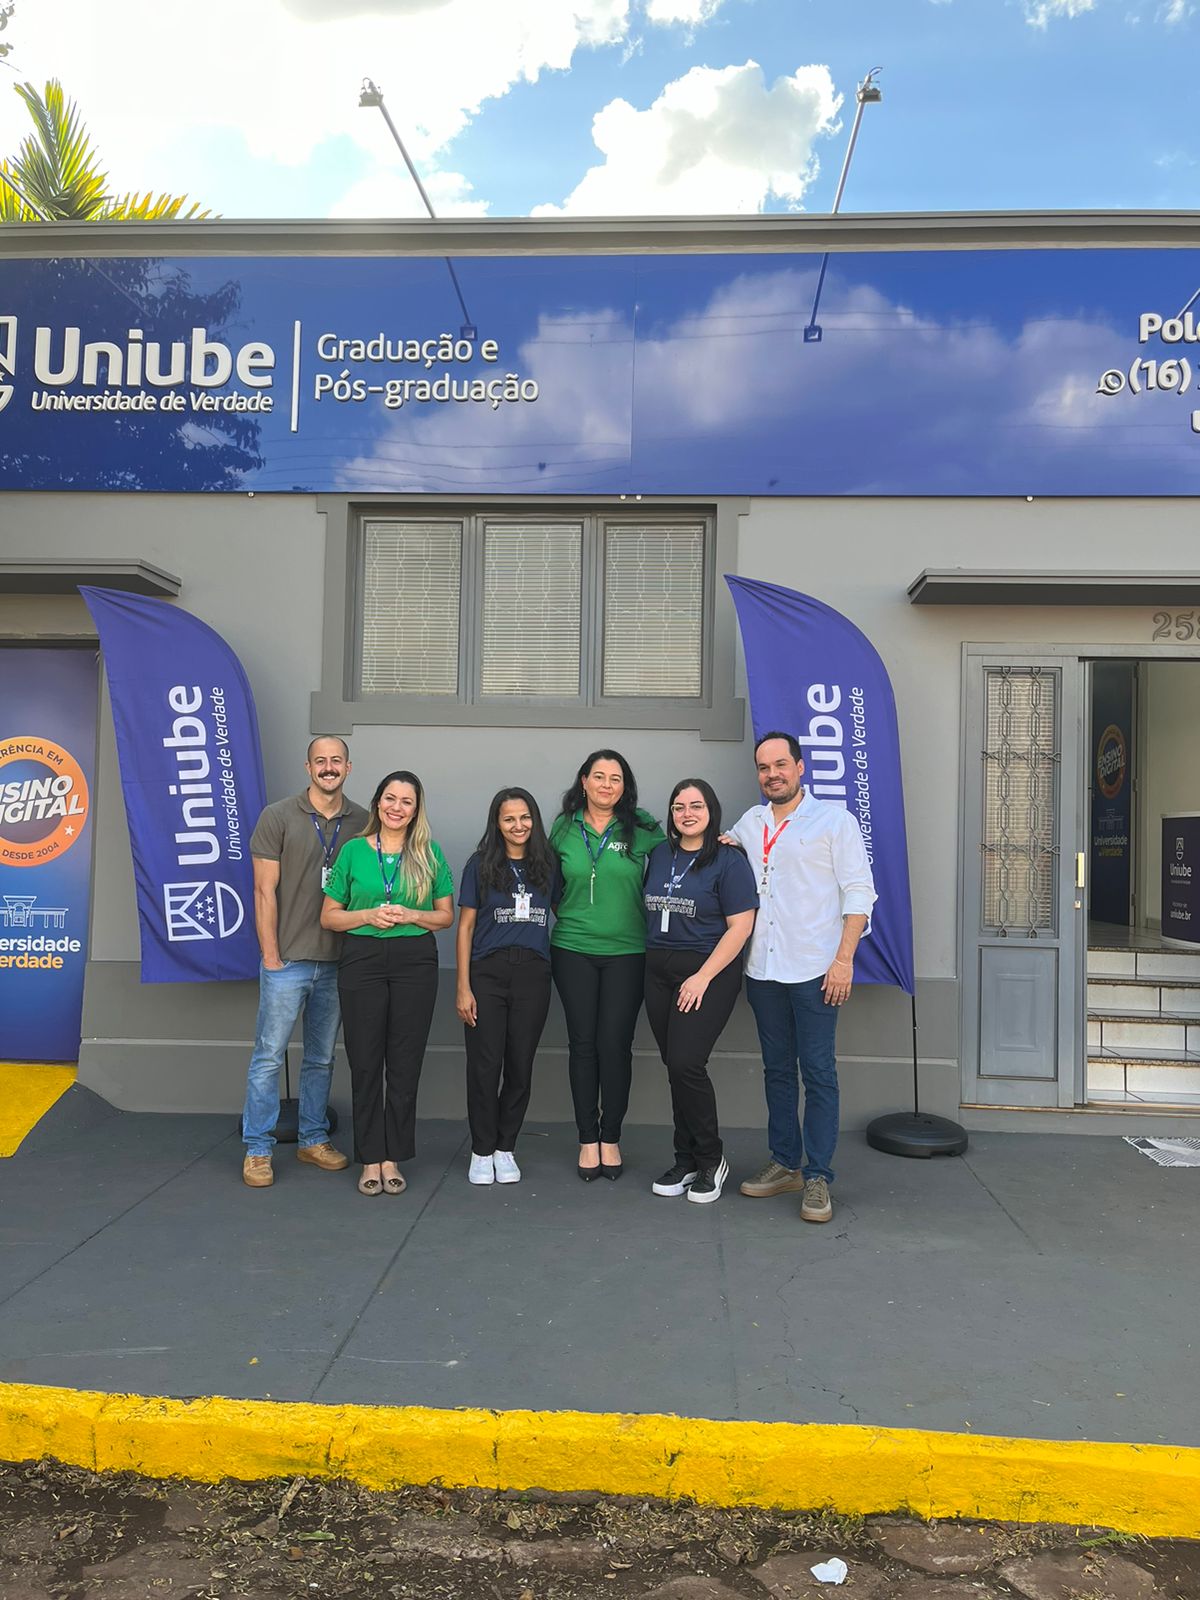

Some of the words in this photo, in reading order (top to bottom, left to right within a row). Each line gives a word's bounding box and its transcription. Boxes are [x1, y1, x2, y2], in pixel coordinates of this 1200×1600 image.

[1138, 311, 1200, 343] Pol
[34, 326, 276, 388] Uniube
[316, 333, 473, 371] Graduação
[480, 337, 499, 362] e
[314, 368, 539, 410] Pós-graduação
[1128, 356, 1192, 394] (16)
[31, 390, 156, 412] Universidade
[159, 392, 186, 412] de
[190, 392, 274, 413] Verdade
[1152, 610, 1200, 642] 25
[209, 686, 228, 747] Verdade
[848, 686, 867, 747] Verdade
[0, 744, 44, 760] RÊNCIA
[46, 750, 64, 766] EM
[216, 748, 231, 768] de
[798, 683, 848, 809] iube
[852, 750, 868, 770] de
[163, 684, 221, 866] Uniube
[218, 769, 243, 861] Universidade
[2, 848, 34, 860] DESDE
[36, 841, 60, 858] 2004
[1169, 862, 1192, 877] Uniube
